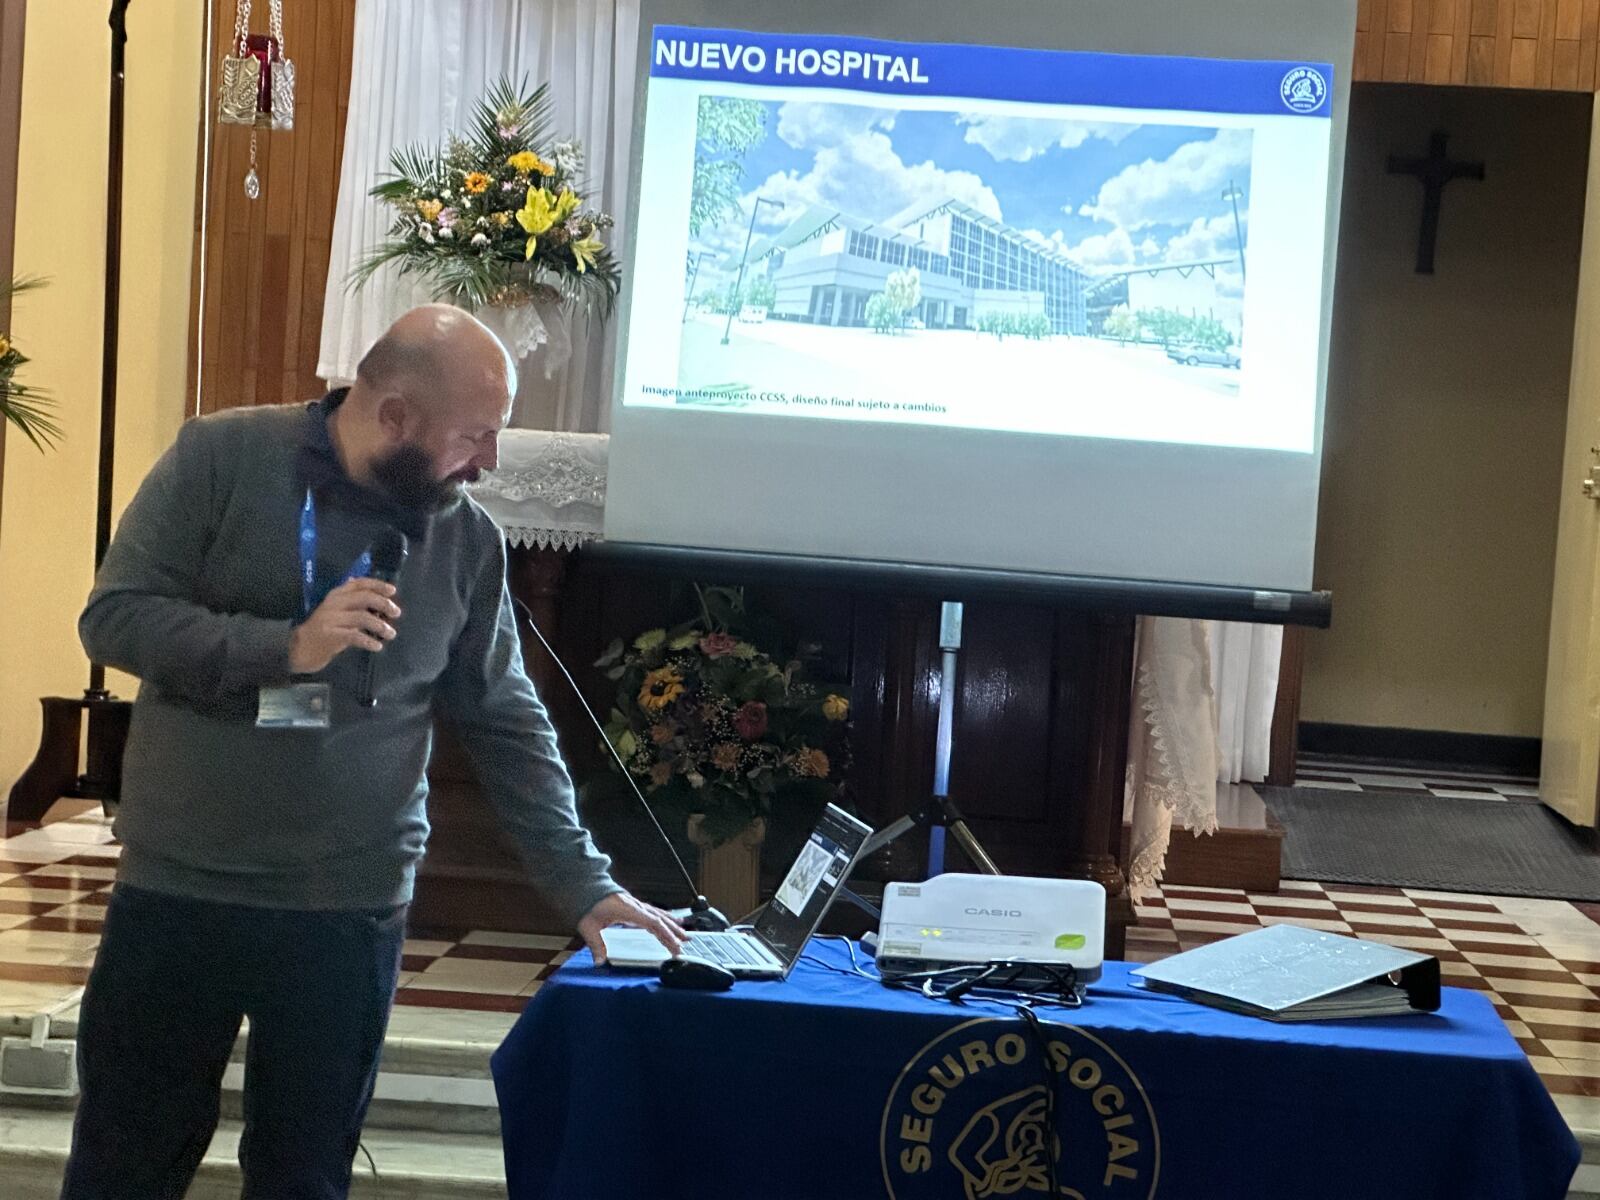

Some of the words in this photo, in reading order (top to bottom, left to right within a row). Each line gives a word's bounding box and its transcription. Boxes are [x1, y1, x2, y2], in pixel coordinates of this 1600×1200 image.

[655, 39, 766, 72] NUEVO
[775, 48, 929, 83] HOSPITAL
[642, 384, 682, 397] Imagen
[685, 388, 757, 400] anteproyecto
[760, 392, 788, 404] CCSS,
[792, 393, 828, 406] diseño
[831, 396, 854, 407] final
[858, 398, 890, 410] sujeto
[893, 402, 899, 410] a
[903, 402, 947, 413] cambios
[964, 907, 1022, 918] CASIO
[900, 1033, 1026, 1173] SEGURO
[1045, 1040, 1139, 1187] SOCIAL
